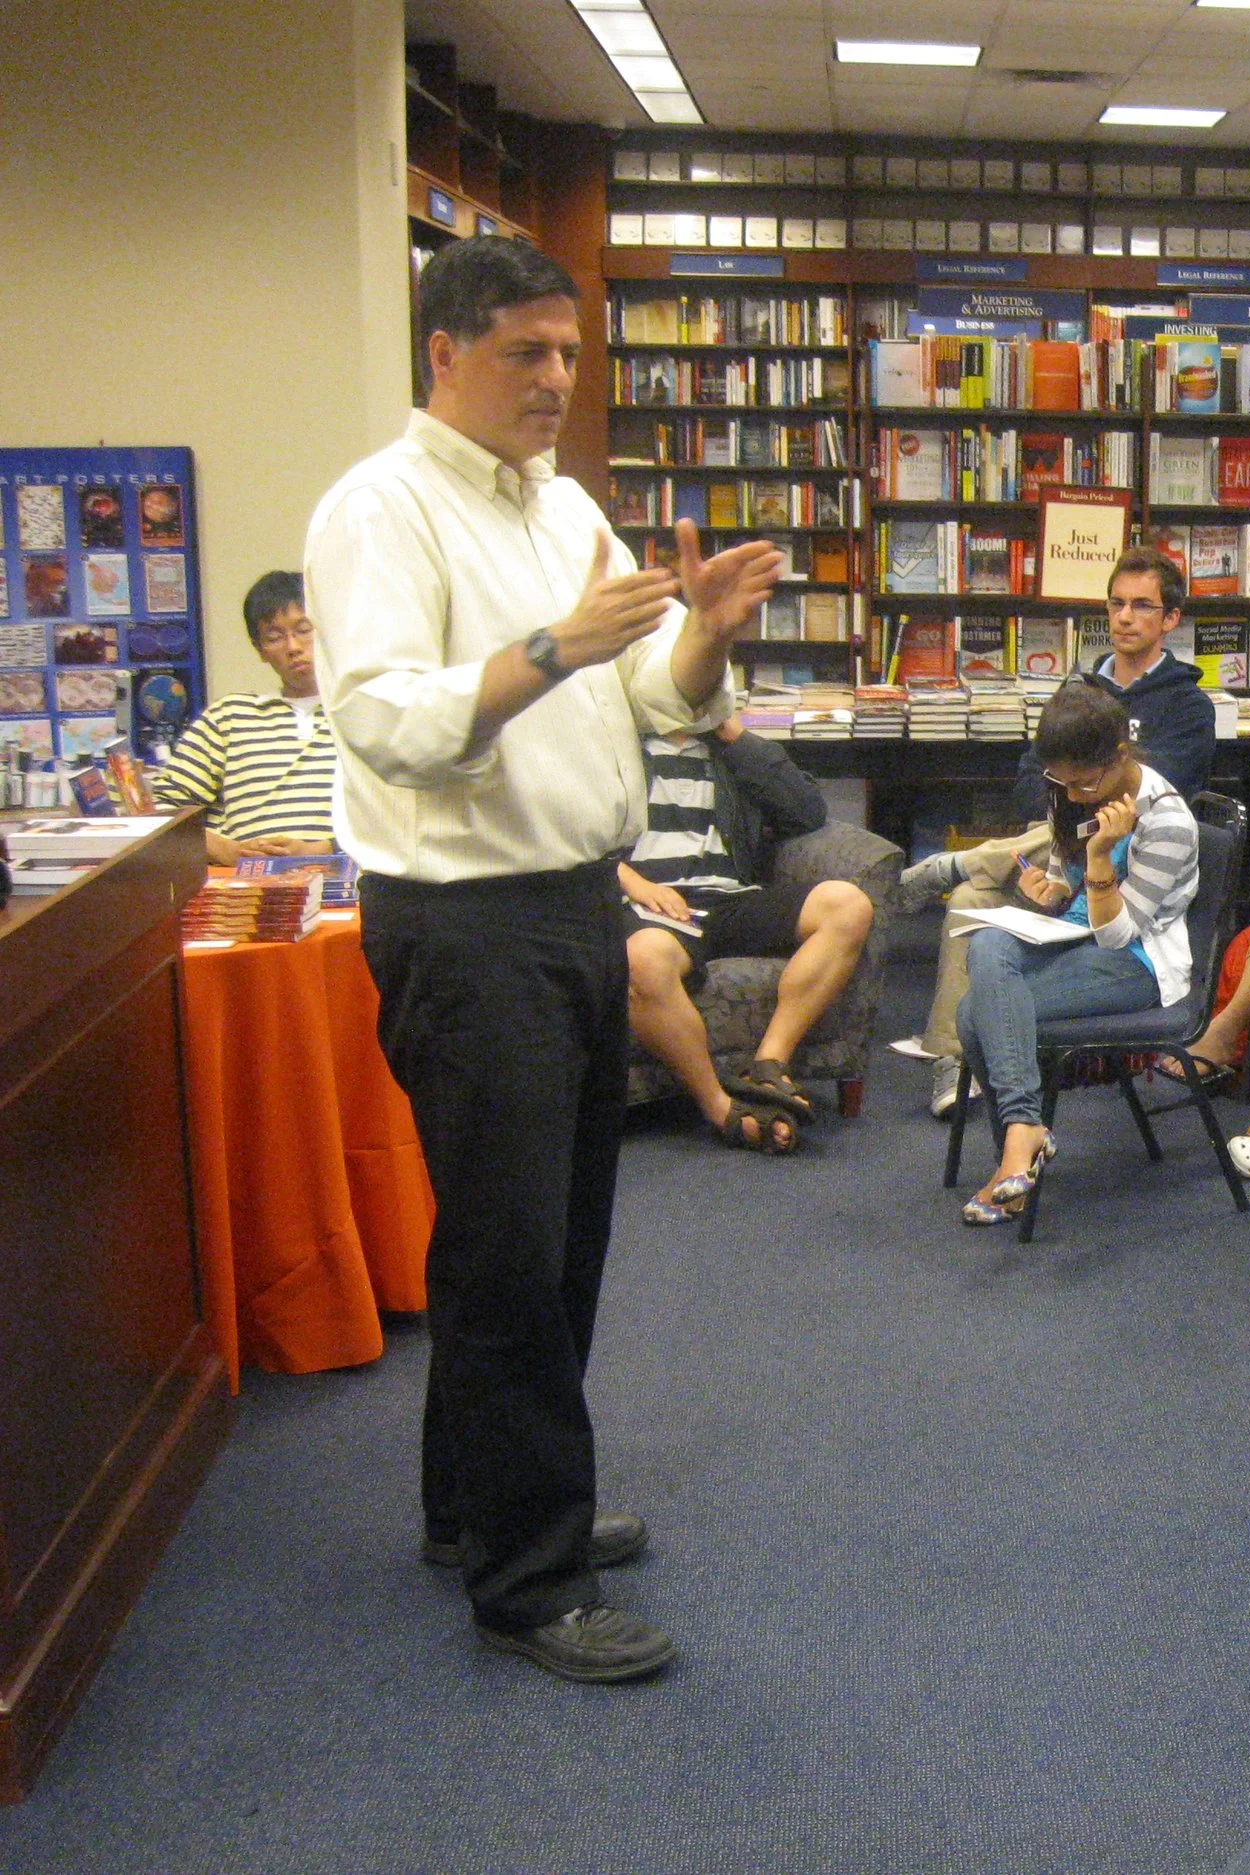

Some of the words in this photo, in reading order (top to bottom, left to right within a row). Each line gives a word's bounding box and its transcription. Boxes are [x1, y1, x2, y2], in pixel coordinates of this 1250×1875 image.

[1178, 270, 1201, 279] LEGAL
[1203, 271, 1244, 281] REFERENCE
[971, 294, 1033, 307] MARKETING
[961, 305, 971, 315] &
[975, 304, 1043, 317] ADVERTISING
[955, 319, 995, 330] BUSINESS
[1164, 324, 1218, 336] INVESTING
[56, 474, 176, 485] POSTERS
[1059, 490, 1088, 501] Bargain
[1089, 492, 1114, 502] Priced
[1067, 529, 1099, 546] Just
[1050, 544, 1116, 562] Reduced
[1082, 635, 1114, 647] WORK
